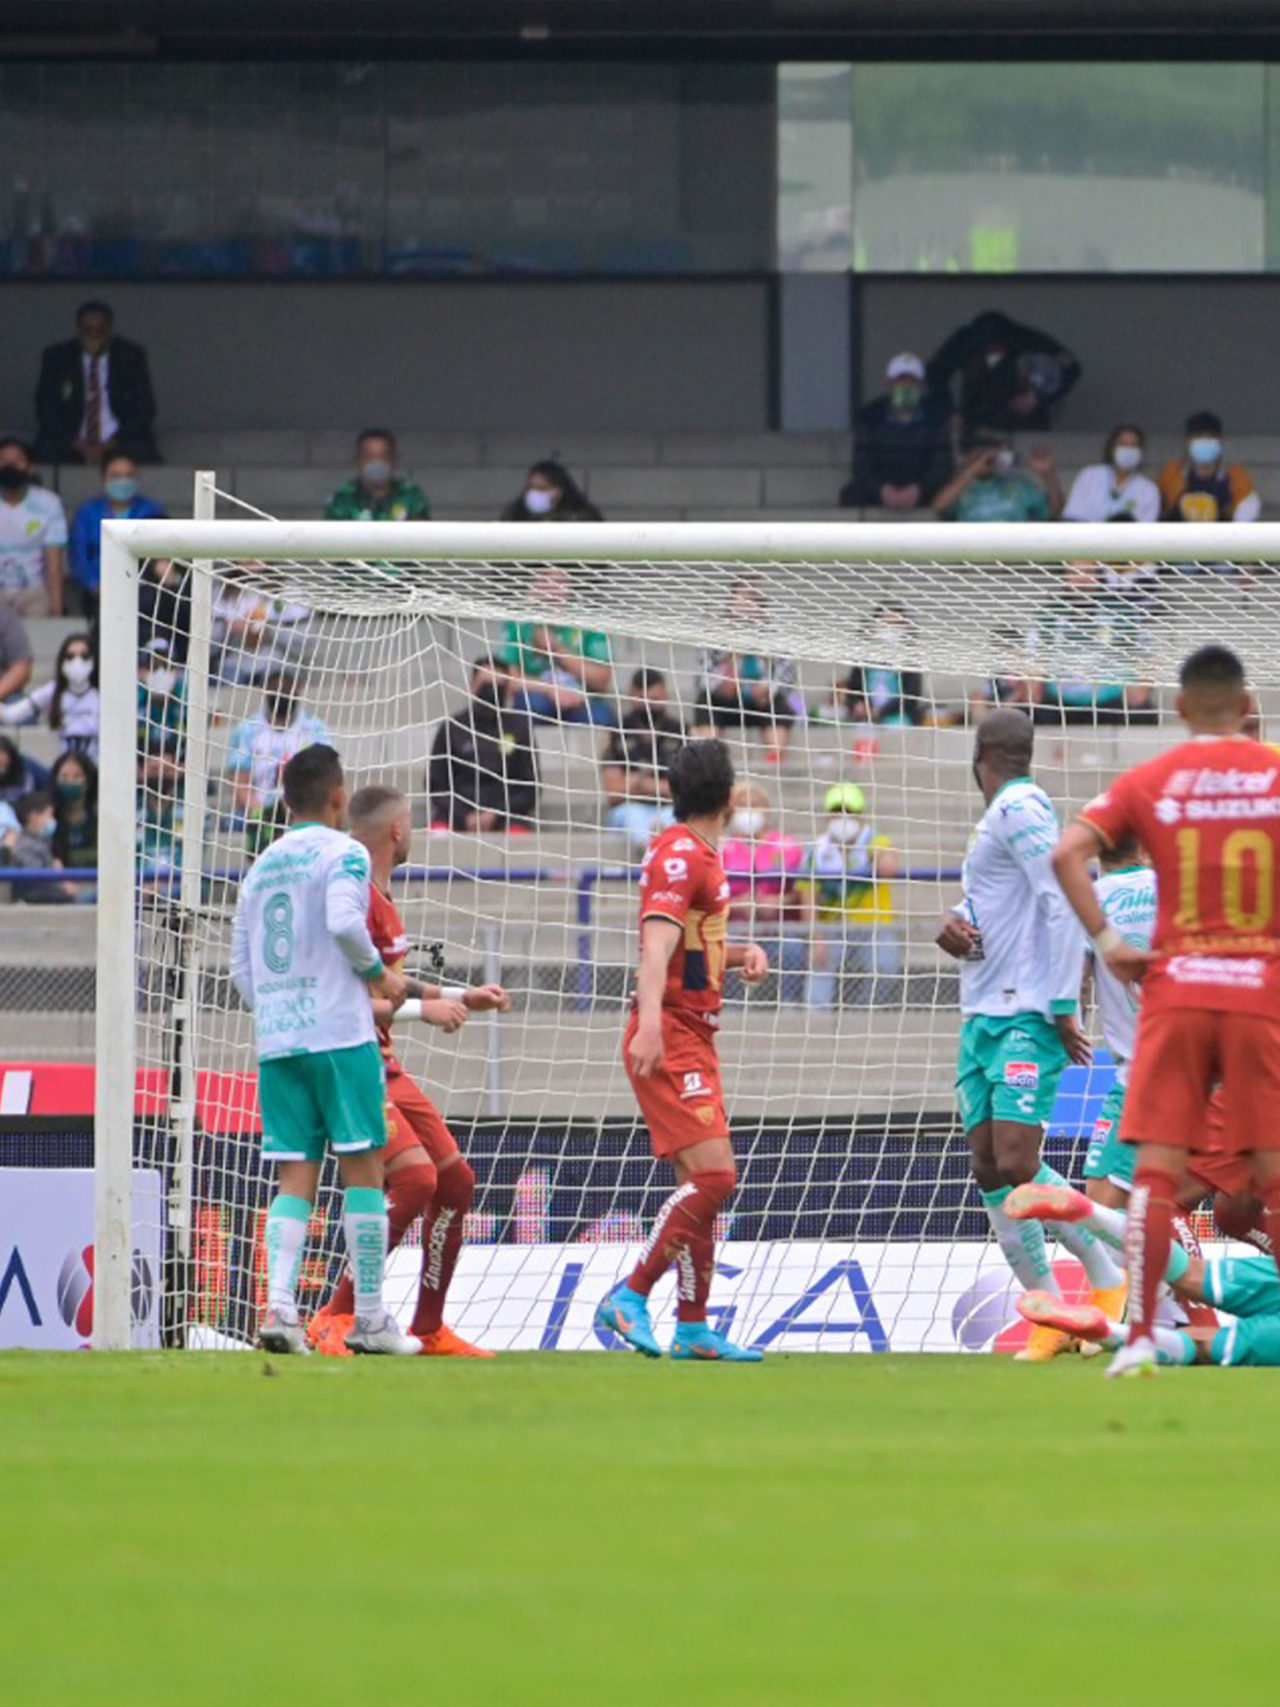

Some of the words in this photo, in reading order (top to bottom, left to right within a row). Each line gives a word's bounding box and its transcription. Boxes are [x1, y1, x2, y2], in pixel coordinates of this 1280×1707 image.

[1191, 767, 1279, 796] telcel
[1173, 826, 1274, 933] 10
[262, 891, 295, 975] 8
